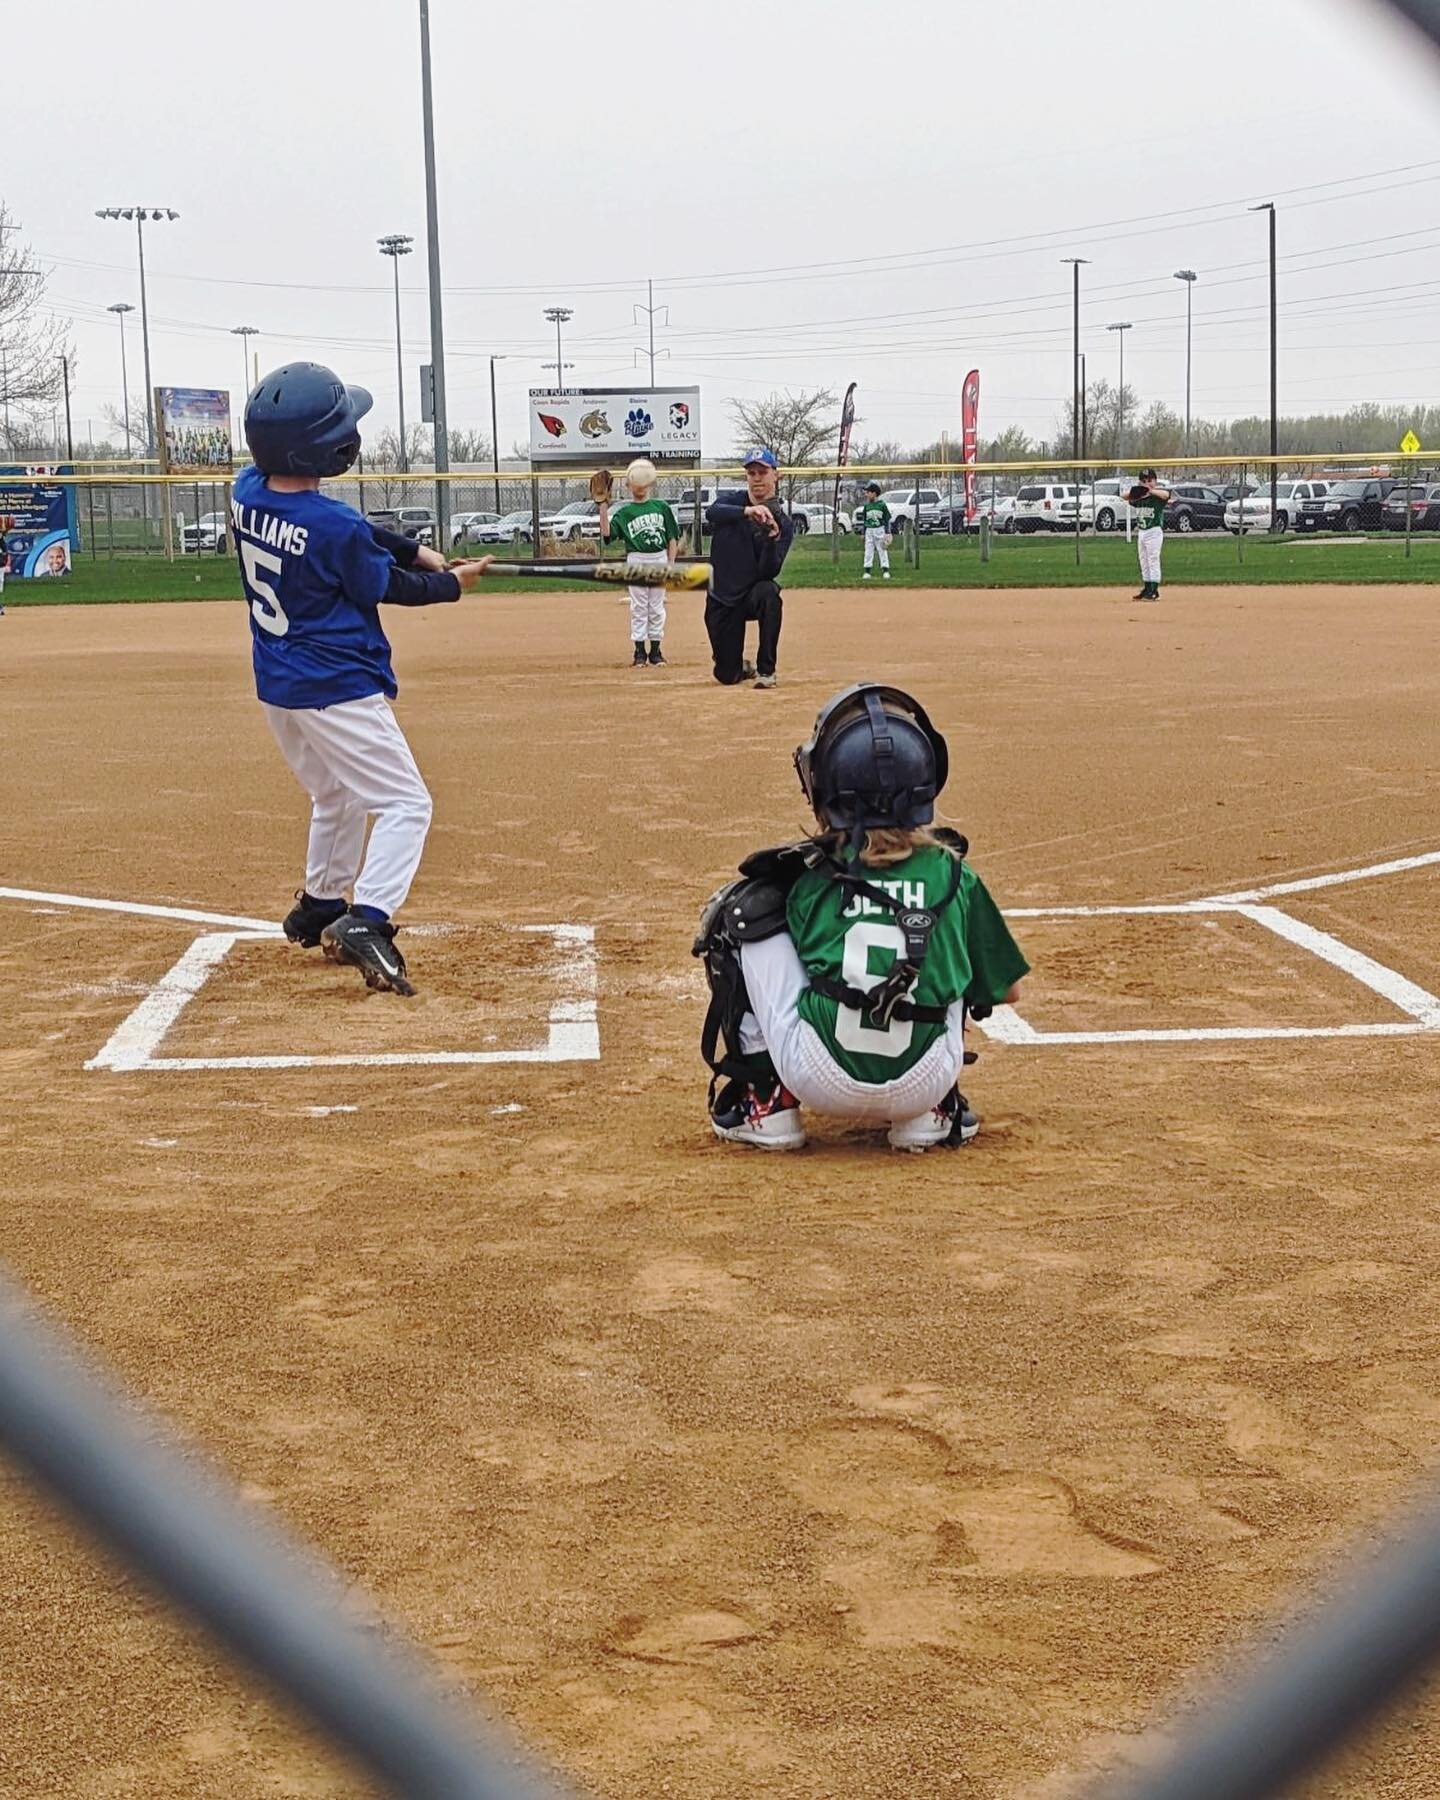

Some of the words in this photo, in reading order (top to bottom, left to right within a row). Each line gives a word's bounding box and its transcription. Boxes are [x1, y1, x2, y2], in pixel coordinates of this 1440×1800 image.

[661, 432, 698, 440] LEGACY
[661, 450, 700, 459] TRAINING
[240, 539, 290, 638] 5
